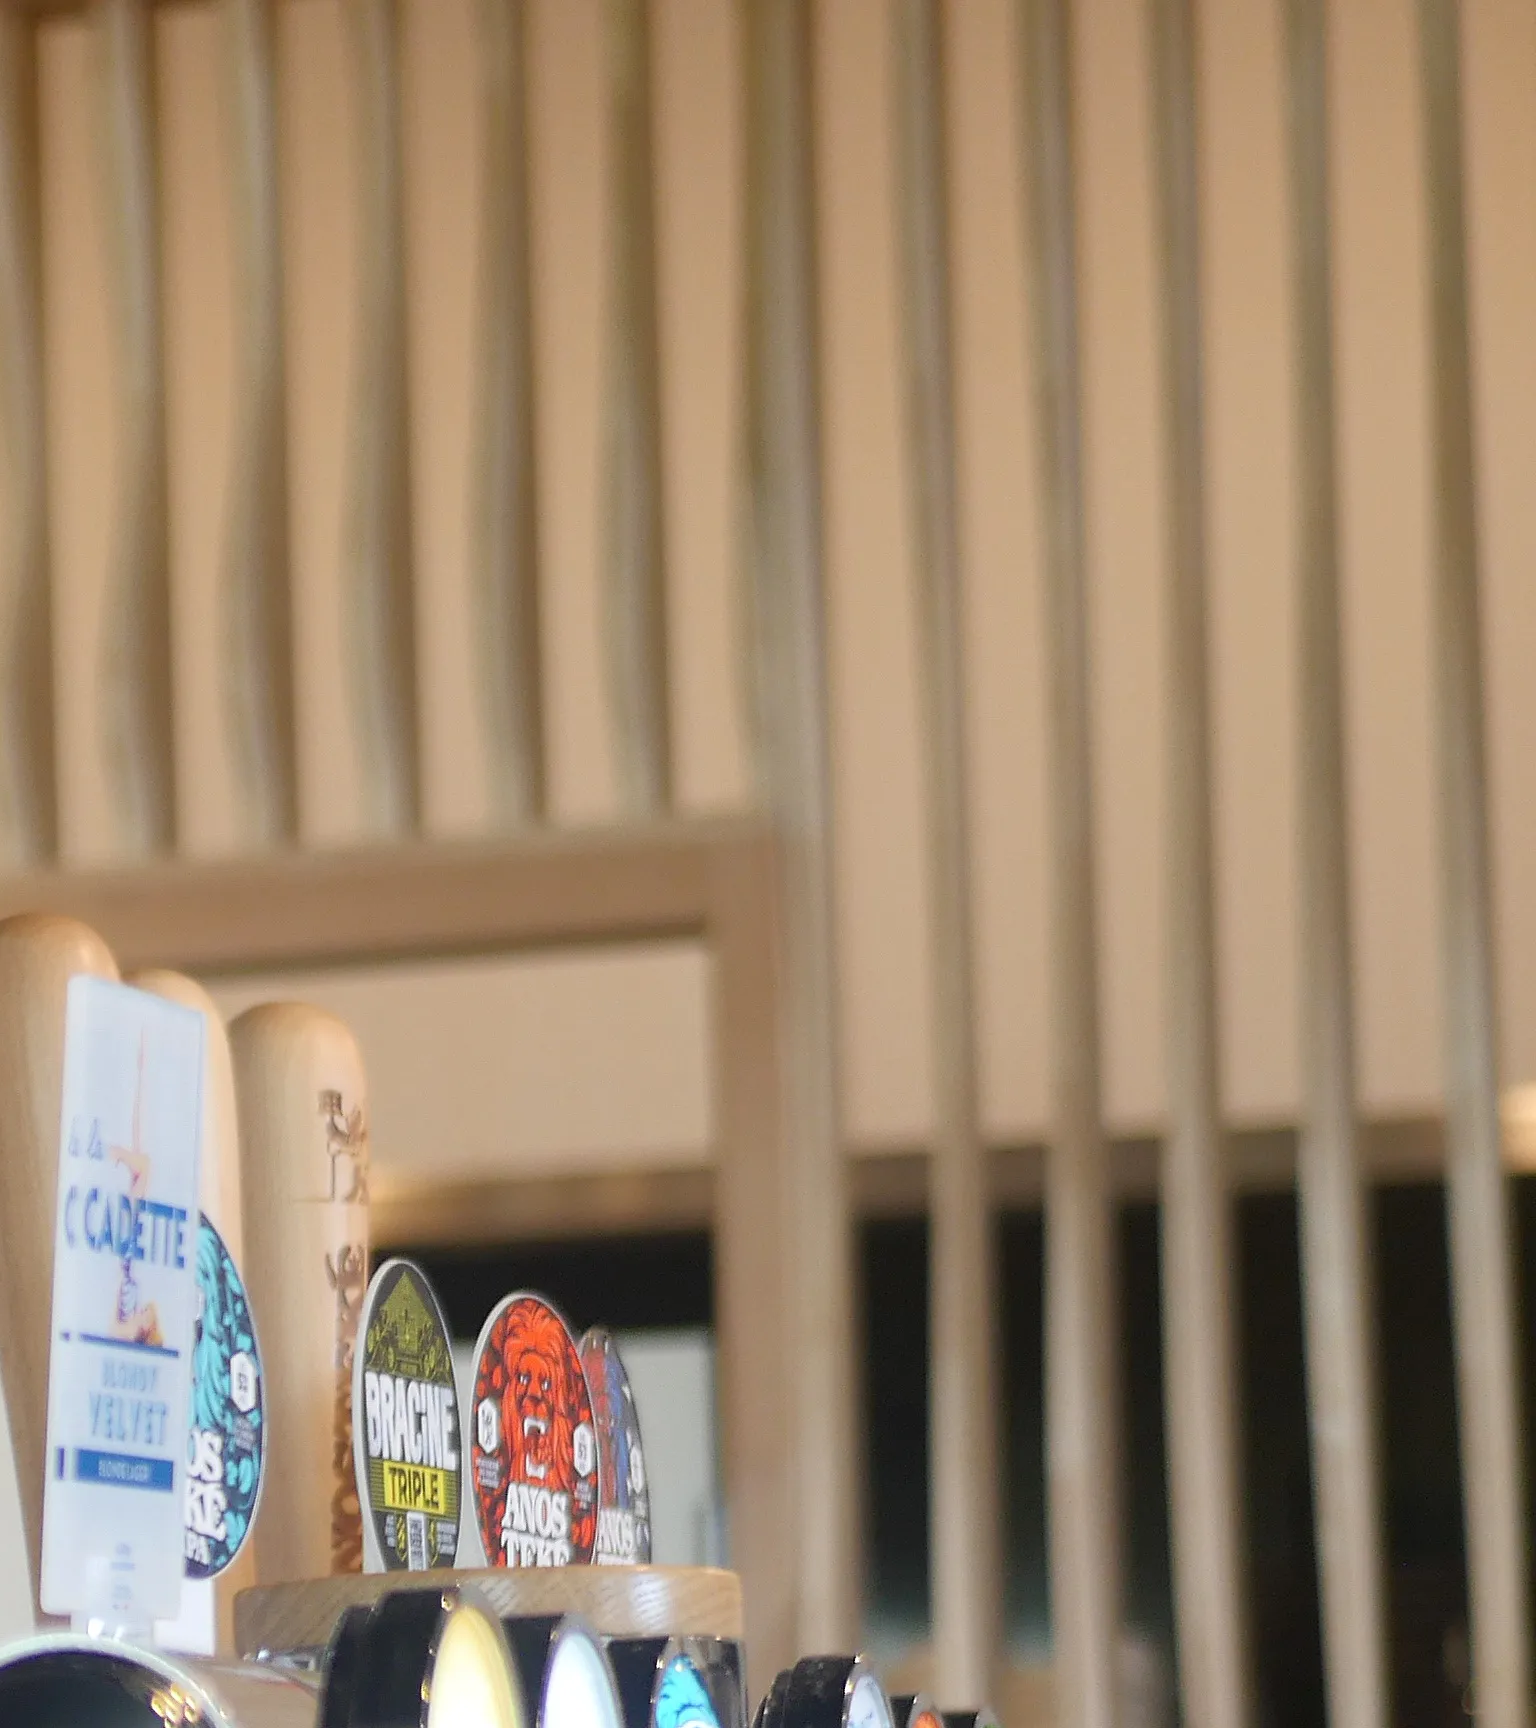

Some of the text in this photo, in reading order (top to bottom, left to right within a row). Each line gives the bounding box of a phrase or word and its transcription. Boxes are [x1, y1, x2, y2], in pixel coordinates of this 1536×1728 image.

[88, 1391, 167, 1446] VELVET
[389, 1468, 439, 1509] TRIPLE
[501, 1482, 569, 1539] ANOS
[597, 1508, 634, 1554] ANOS
